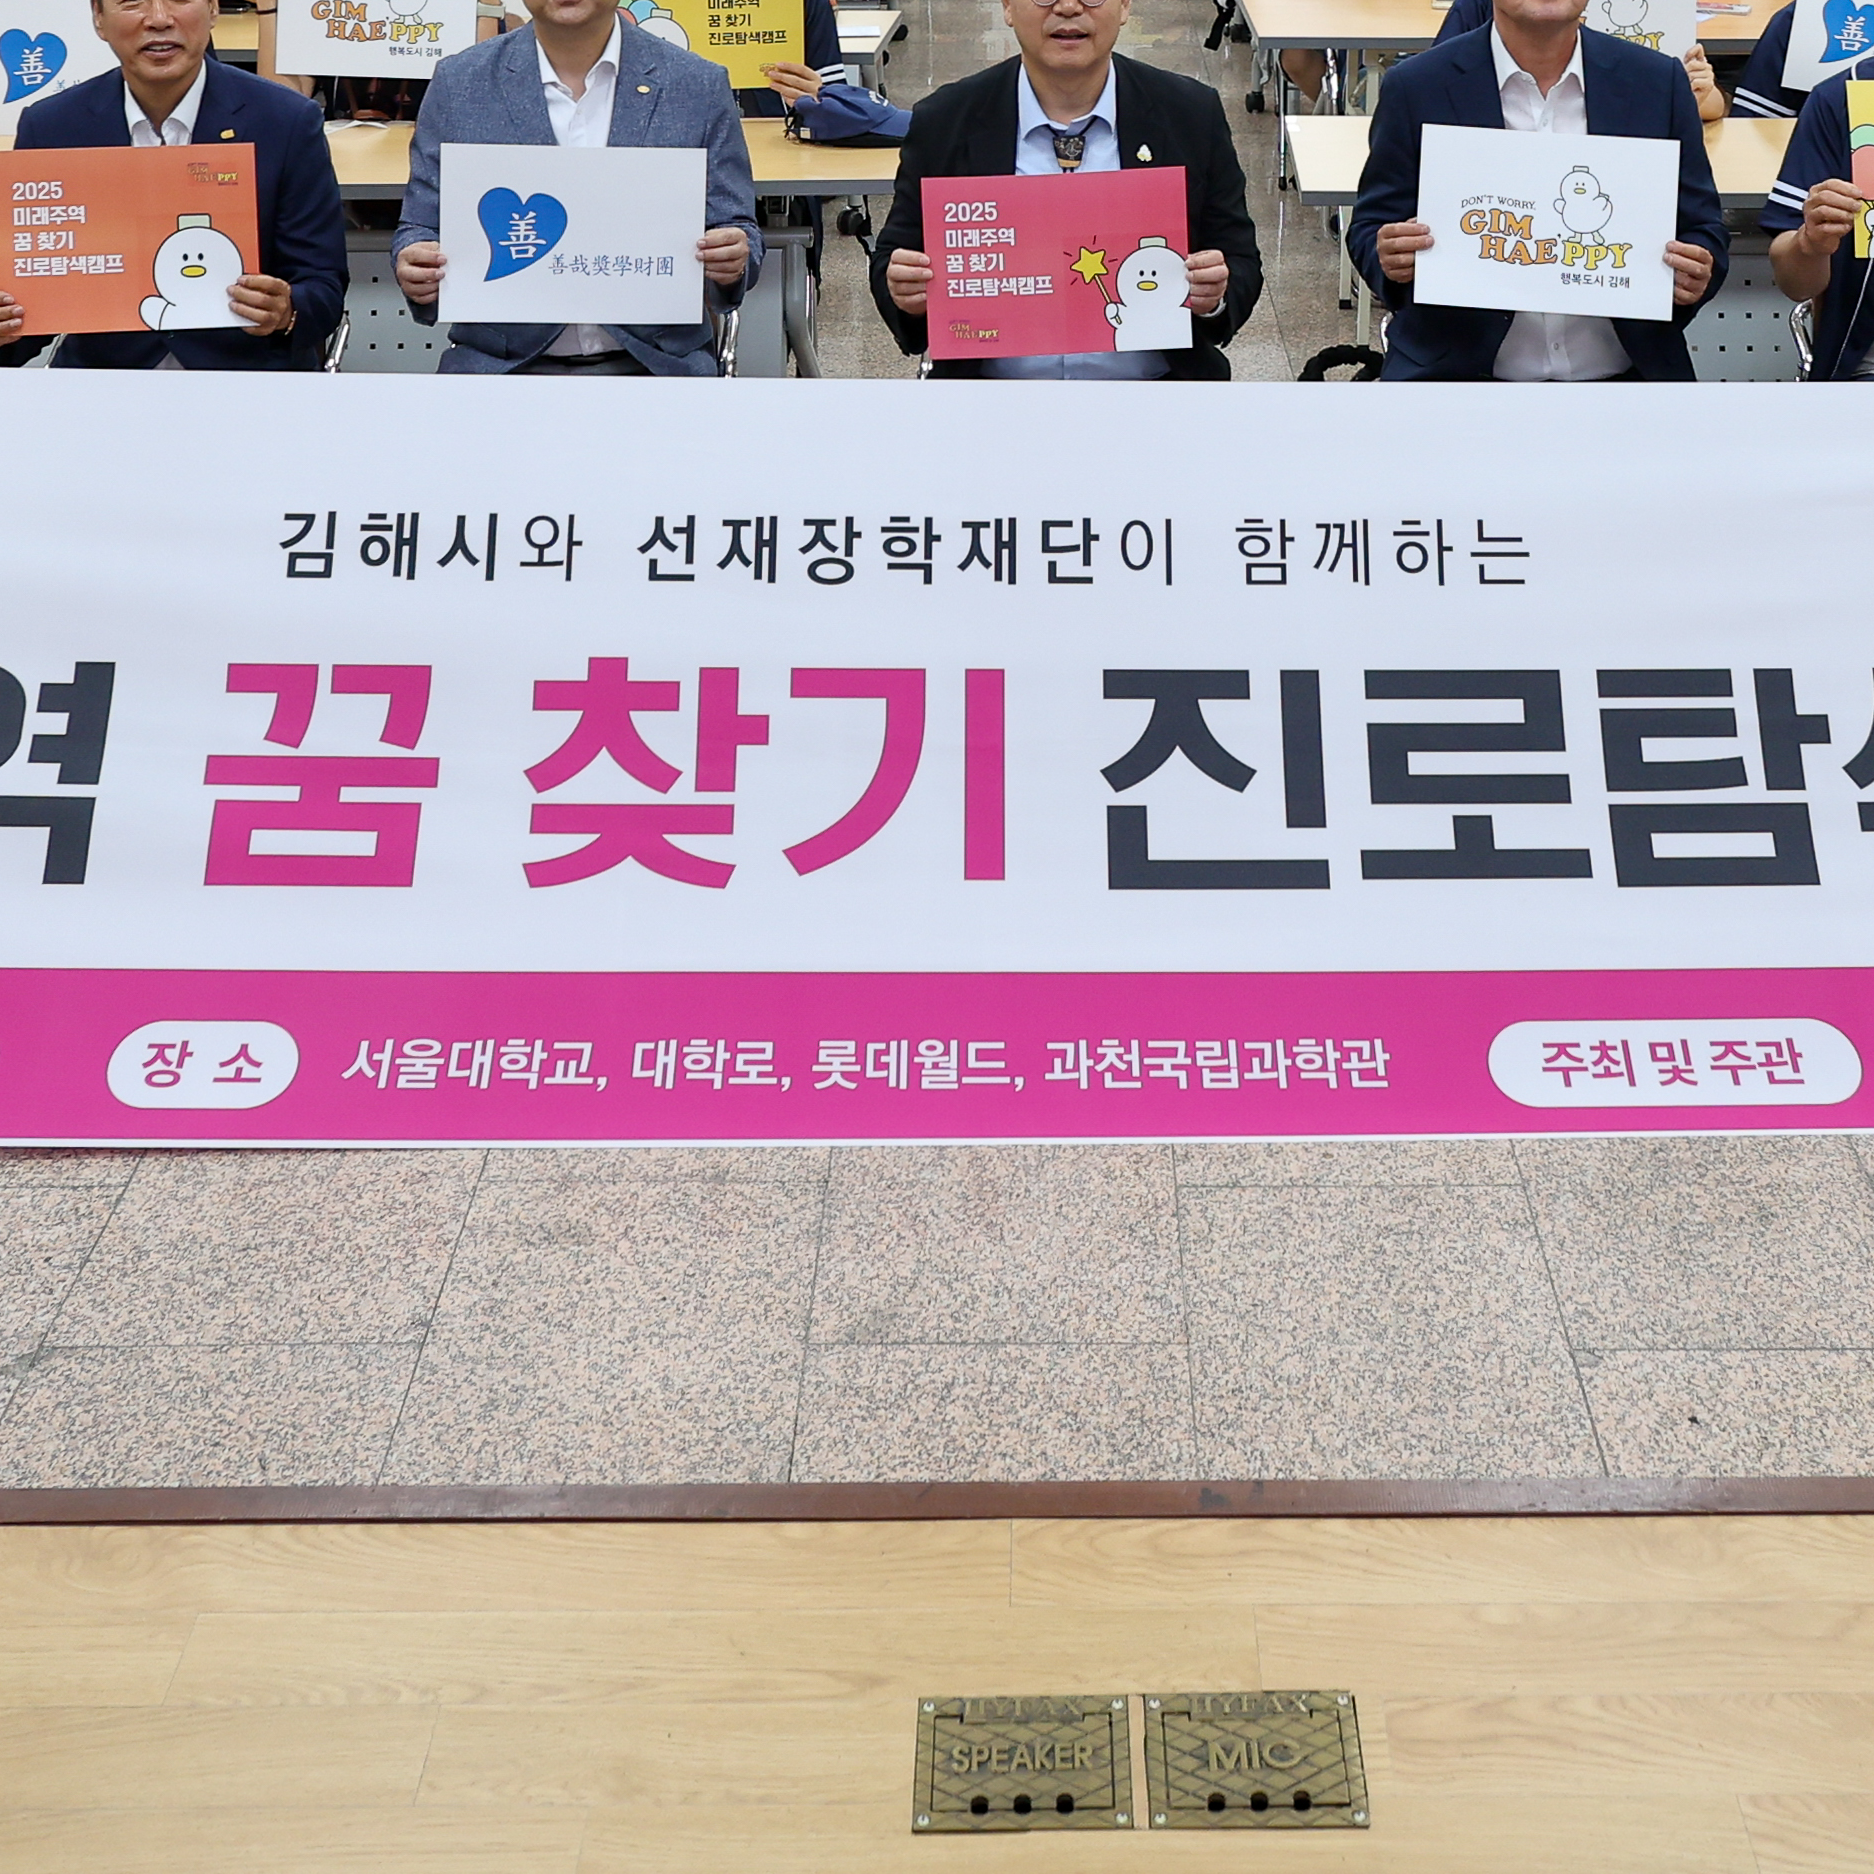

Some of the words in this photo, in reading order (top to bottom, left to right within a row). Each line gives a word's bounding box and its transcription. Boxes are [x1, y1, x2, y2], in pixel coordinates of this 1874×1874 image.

[311, 0, 368, 22] GIM
[708, 15, 720, 27] 꿈
[726, 14, 750, 27] 찾기
[709, 30, 787, 45] 진로탐색캠프
[1834, 15, 1870, 52] 善
[389, 47, 422, 56] 행복도시
[426, 48, 442, 57] 김해
[14, 48, 51, 86] 善
[12, 182, 62, 200] 2025
[1461, 194, 1494, 208] DON'T
[14, 205, 86, 226] 미래주역
[945, 202, 998, 222] 2025
[1460, 208, 1533, 240] GIM
[14, 233, 32, 252] 꿈
[37, 231, 74, 250] 찾기
[498, 211, 546, 259] 善
[946, 228, 1016, 247] 미래주역
[14, 254, 124, 277] 진로탐색캠프
[946, 255, 964, 272] 꿈
[969, 253, 1004, 272] 찾기
[948, 276, 1053, 297] 진로탐색캠프
[1561, 273, 1603, 286] 행복도시
[1609, 276, 1629, 288] 김해
[279, 511, 582, 581] 김해시와
[637, 515, 1172, 585] 선재장학재단이
[1236, 519, 1530, 586] 함께하는
[204, 663, 440, 887] 꿈
[522, 657, 1005, 889] 찾기
[342, 1039, 608, 1091] 서울대학교,
[632, 1040, 790, 1091] 대학로,
[812, 1040, 1025, 1091] 롯데월드,
[1044, 1039, 1390, 1089] 과천국립과학관
[1542, 1040, 1635, 1087] 주최
[1649, 1039, 1698, 1086] 및
[1710, 1038, 1804, 1085] 주관
[952, 1741, 1094, 1774] SPEAKER
[1207, 1739, 1302, 1772] MIC
